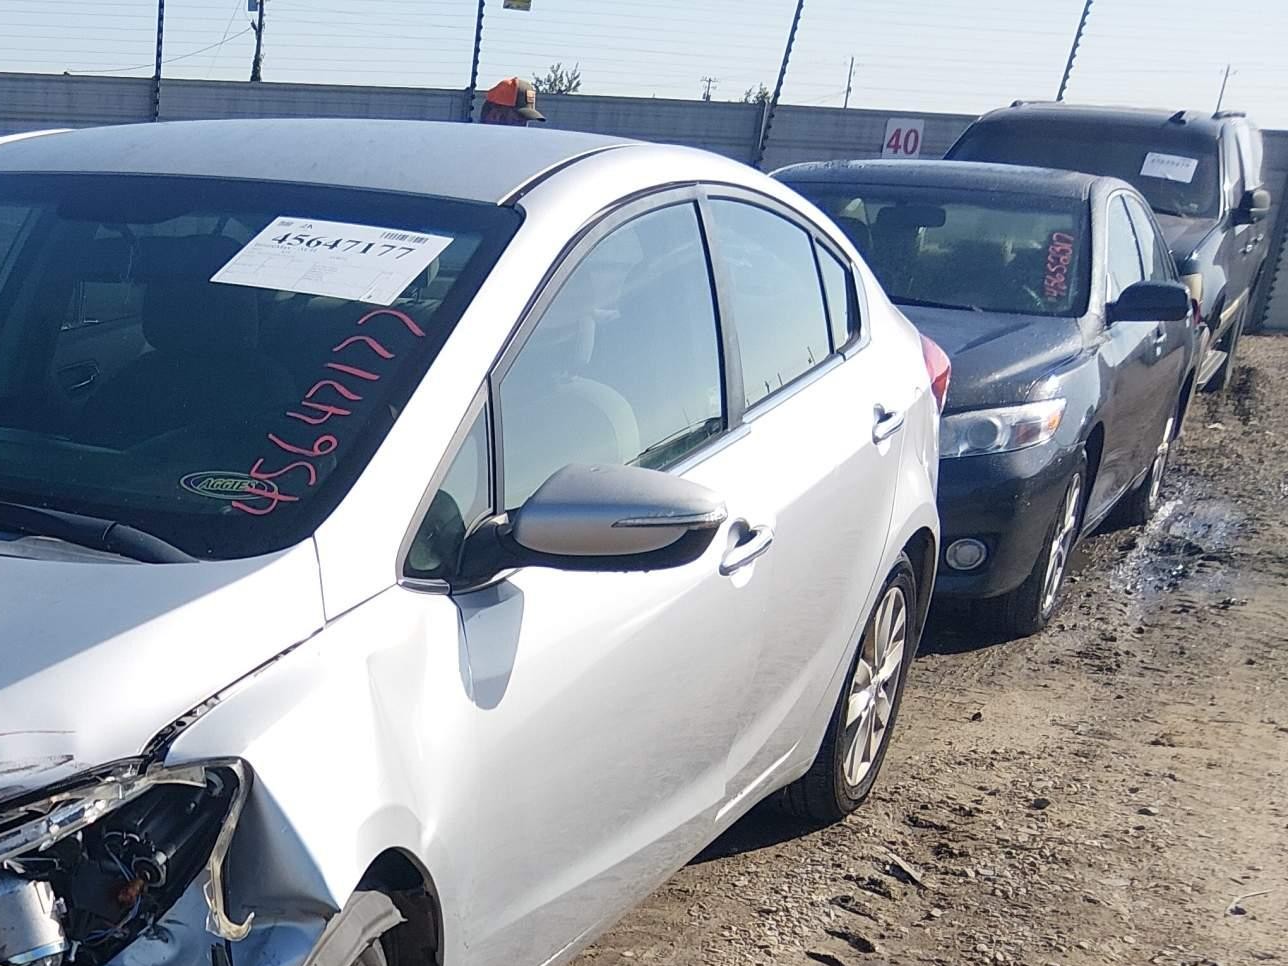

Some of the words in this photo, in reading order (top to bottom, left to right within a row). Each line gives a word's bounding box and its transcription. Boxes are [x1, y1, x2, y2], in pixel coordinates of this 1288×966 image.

[886, 128, 919, 155] 40
[272, 231, 417, 260] 45647177
[232, 309, 426, 515] 45647177
